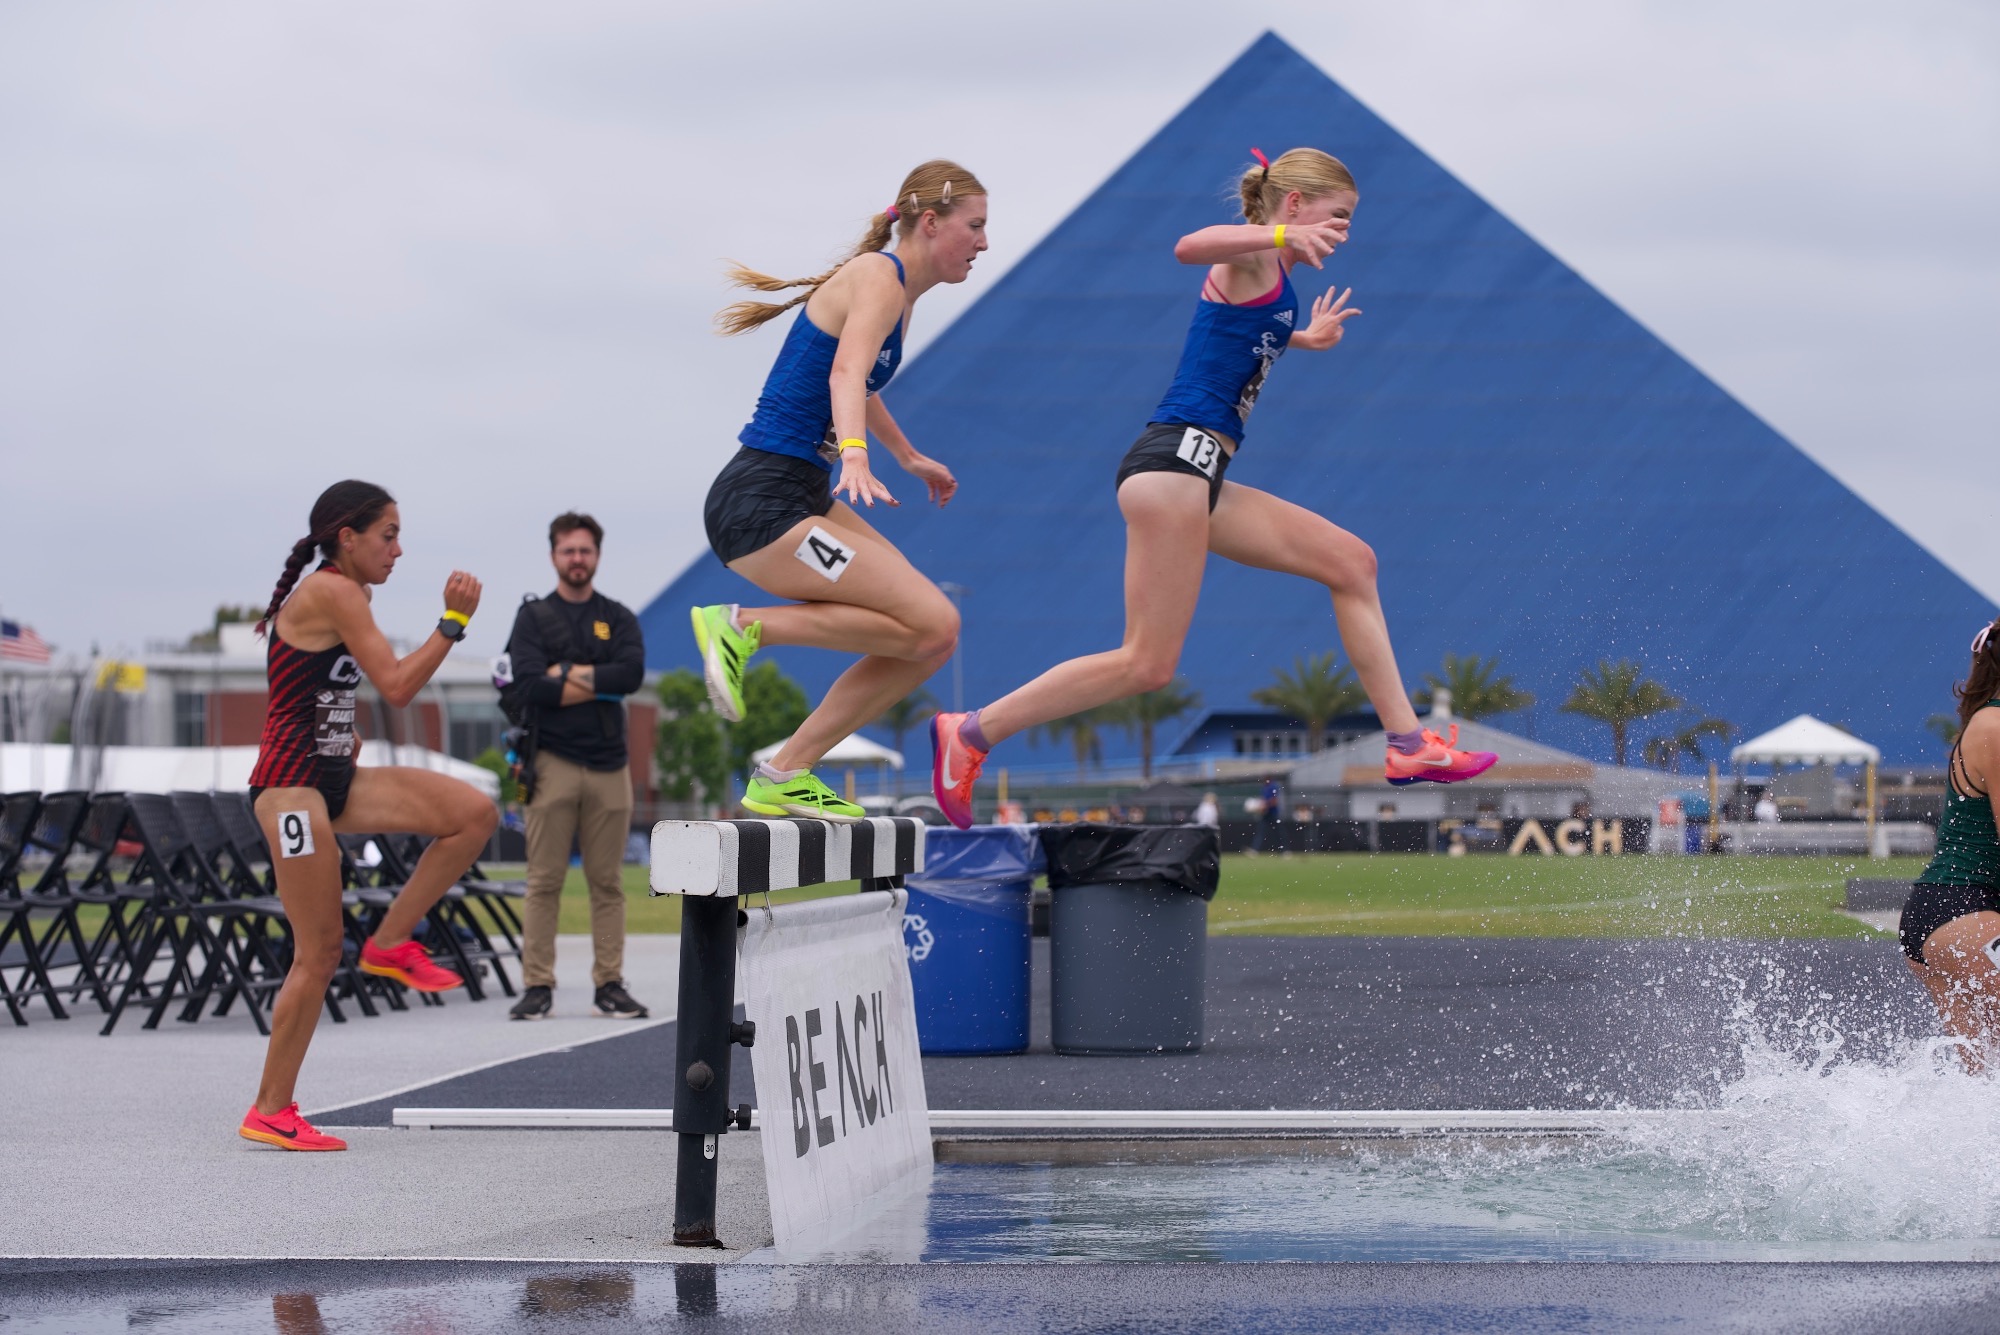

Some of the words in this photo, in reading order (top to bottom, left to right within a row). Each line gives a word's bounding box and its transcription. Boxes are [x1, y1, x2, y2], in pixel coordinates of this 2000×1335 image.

[1190, 433, 1216, 470] 13
[808, 535, 848, 570] 4
[284, 813, 305, 855] 9
[785, 990, 894, 1159] BEACH
[705, 1144, 715, 1153] 30
